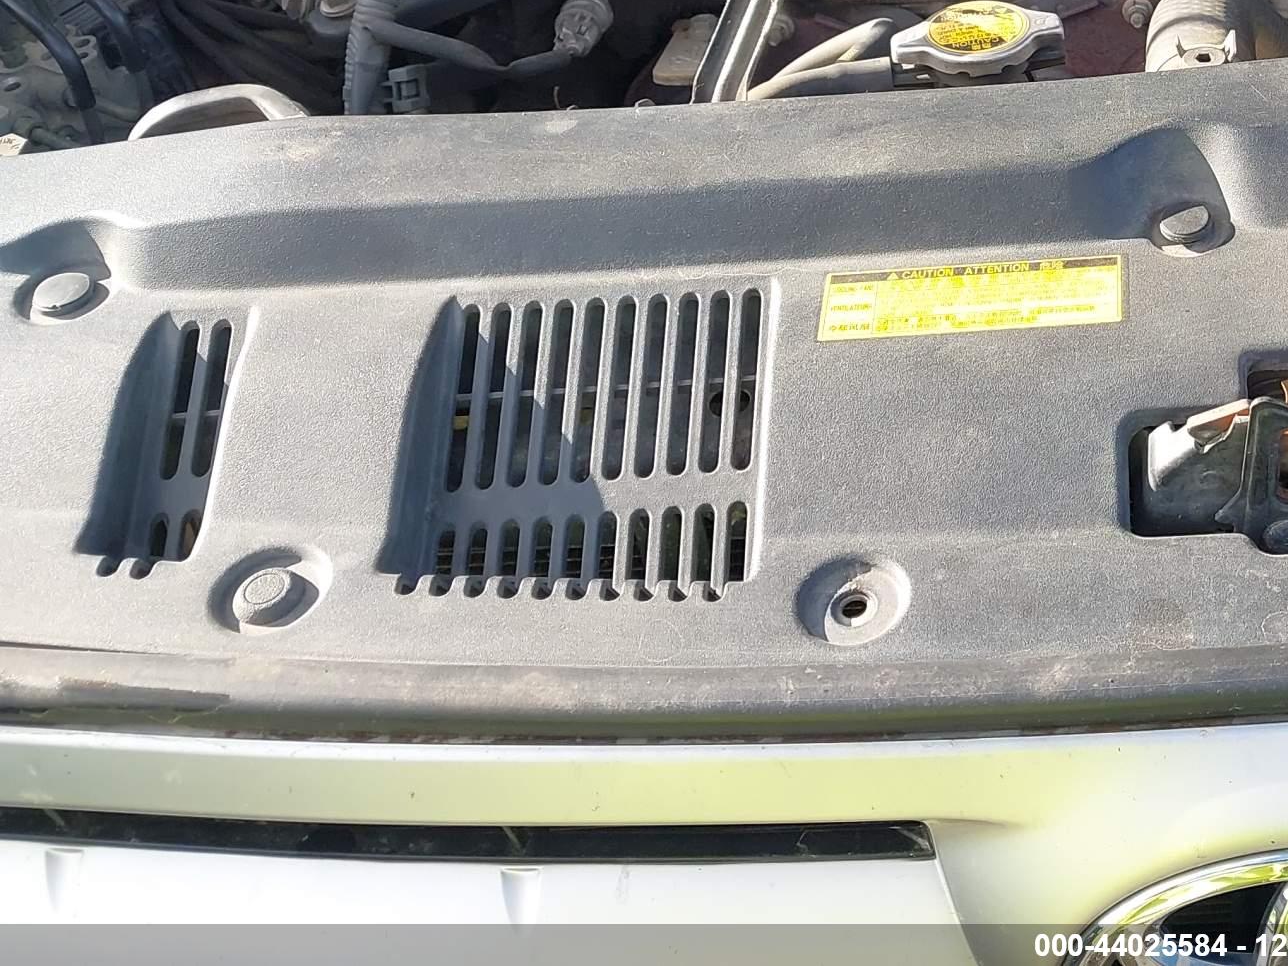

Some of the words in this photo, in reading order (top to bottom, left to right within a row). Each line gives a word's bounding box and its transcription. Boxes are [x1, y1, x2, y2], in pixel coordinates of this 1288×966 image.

[952, 37, 999, 49] CAUTION
[902, 267, 954, 280] CAUTION
[964, 262, 1030, 276] ATTENTION
